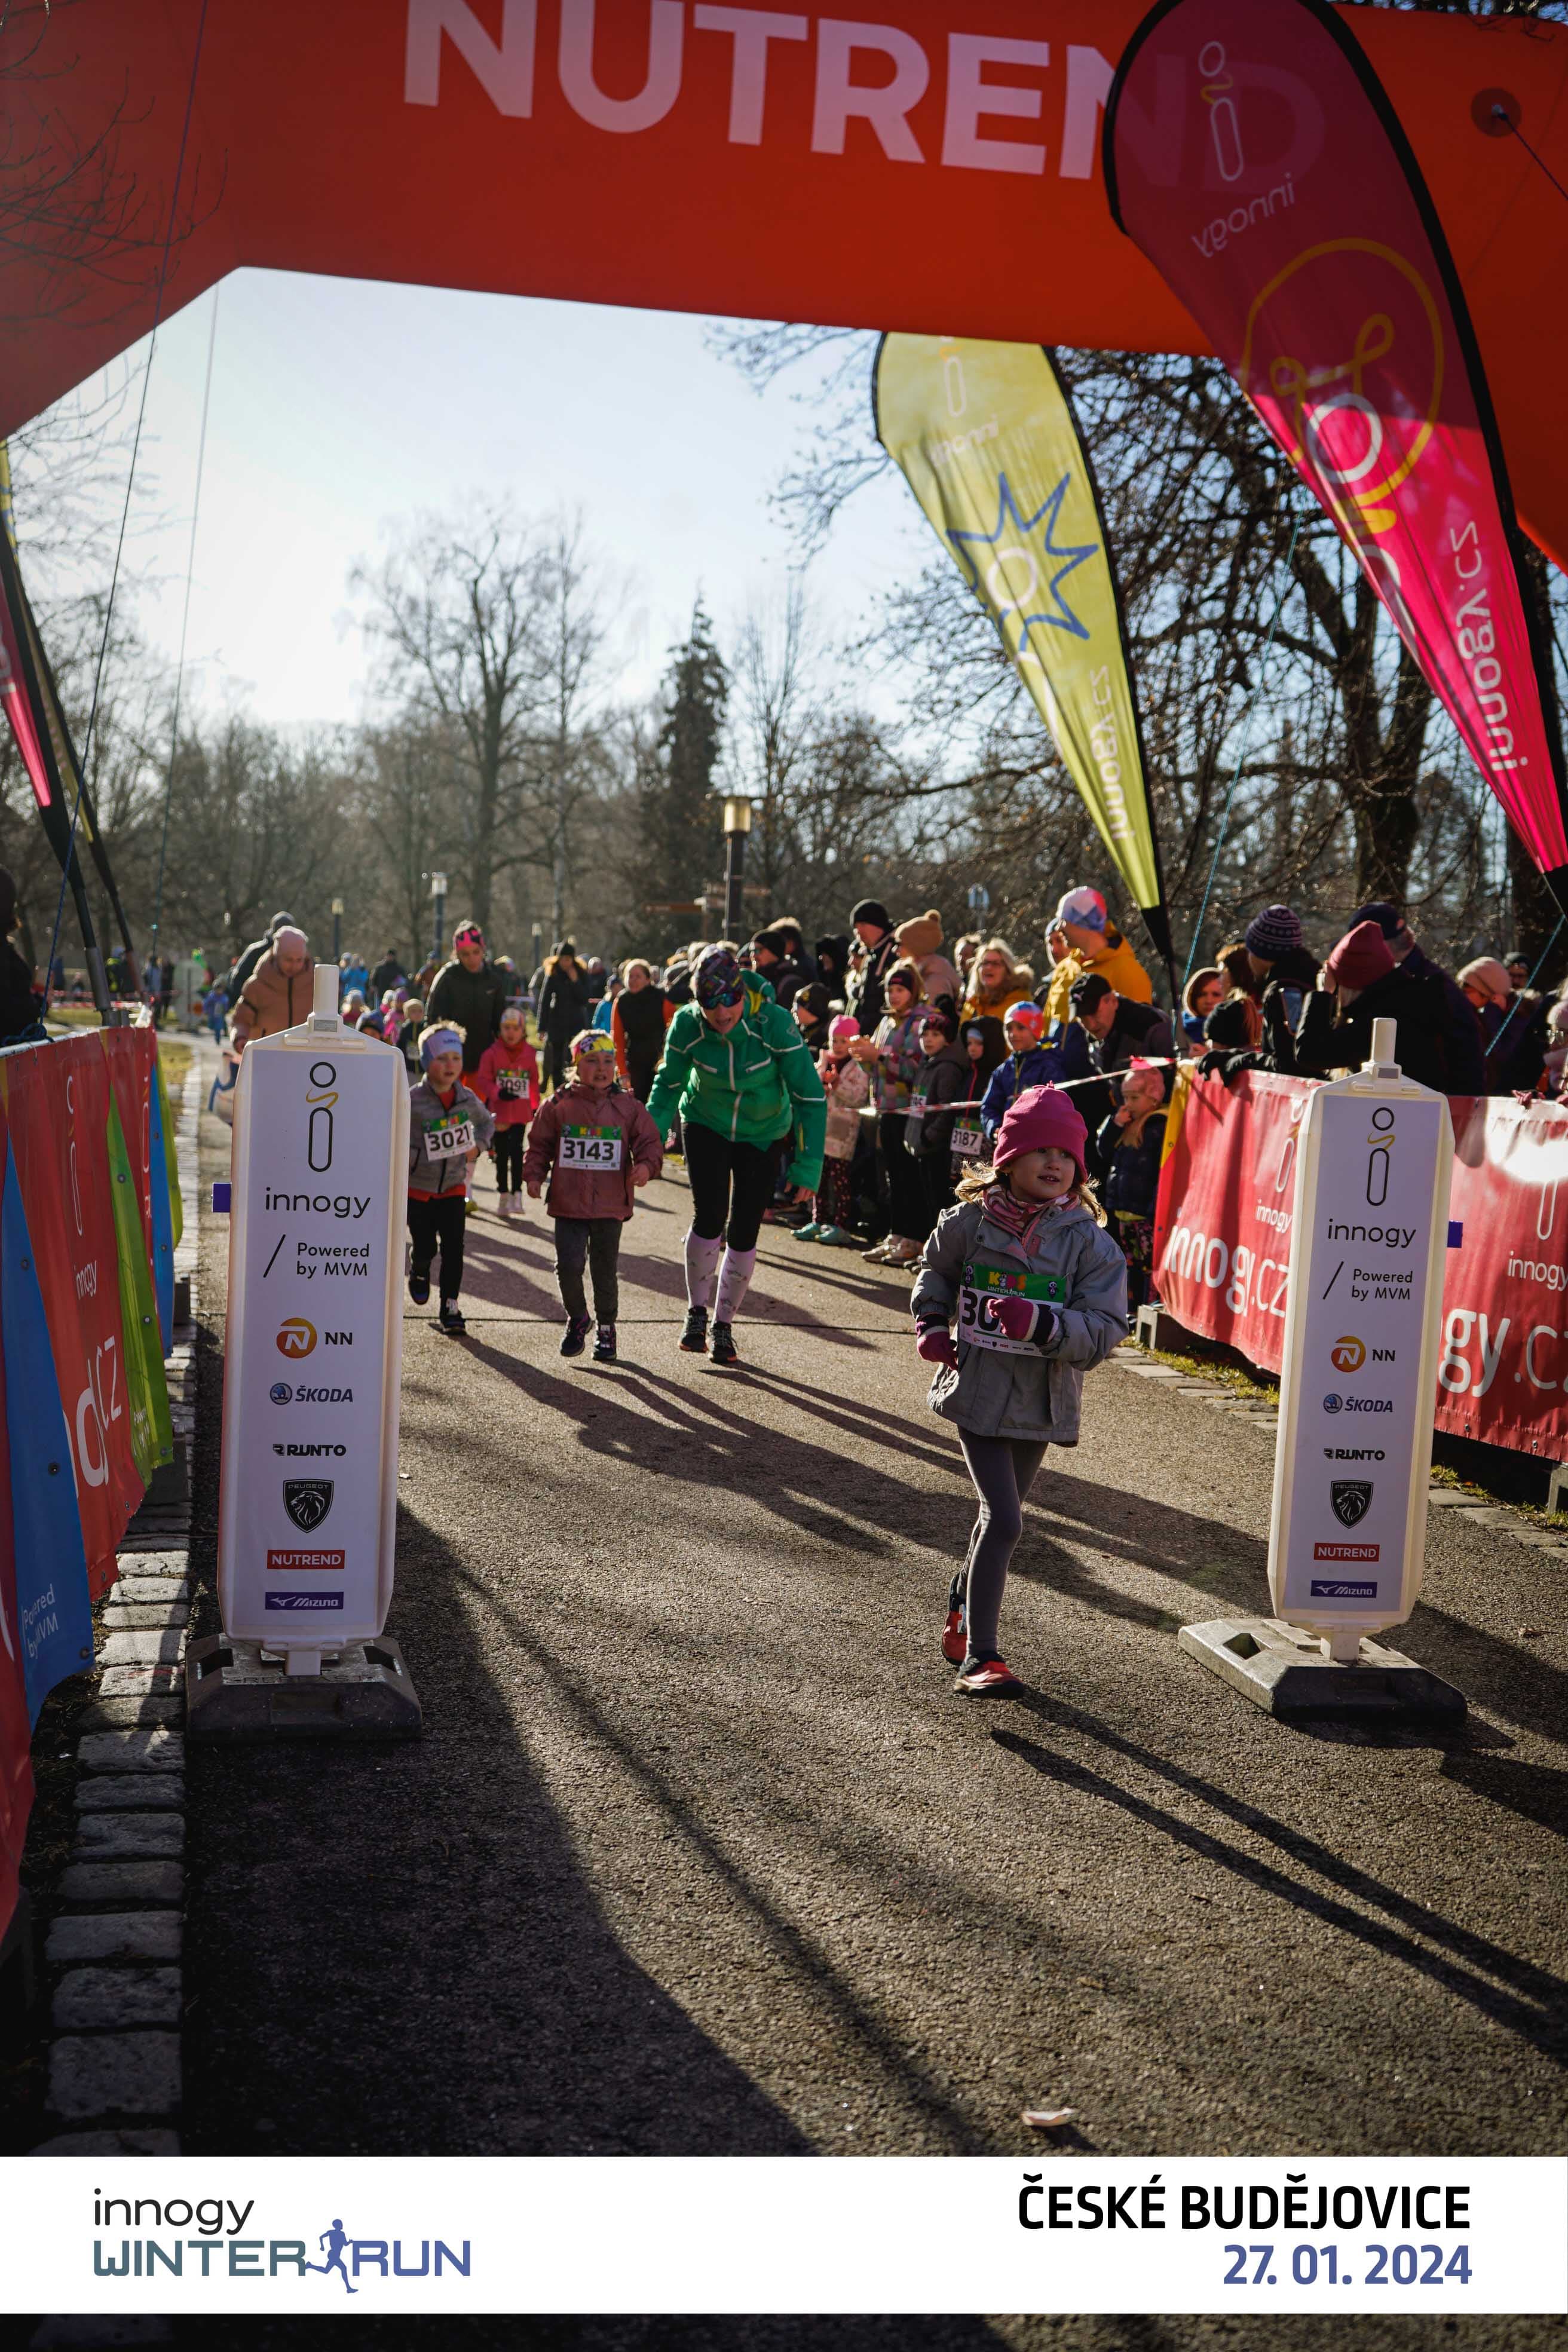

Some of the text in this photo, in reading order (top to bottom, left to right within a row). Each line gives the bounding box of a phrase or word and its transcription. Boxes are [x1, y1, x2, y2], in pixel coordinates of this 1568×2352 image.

[428, 1125, 470, 1151] 3021
[563, 1139, 614, 1160] 3143
[265, 1187, 370, 1218] innogy
[1255, 1199, 1292, 1233] innogy
[1328, 1218, 1416, 1248] innogy
[297, 1242, 370, 1257] Powered
[296, 1261, 368, 1279] by MVM
[1353, 1268, 1413, 1284] Powered
[1507, 1250, 1568, 1291] innogy
[1351, 1285, 1411, 1301] by MVM
[324, 1331, 353, 1345] NN
[1372, 1349, 1396, 1362] NN
[295, 1385, 354, 1402] ŠKODA
[1344, 1396, 1394, 1413] ŠKODA
[272, 1554, 341, 1565] NUTREND
[1318, 1546, 1377, 1558] NUTREND
